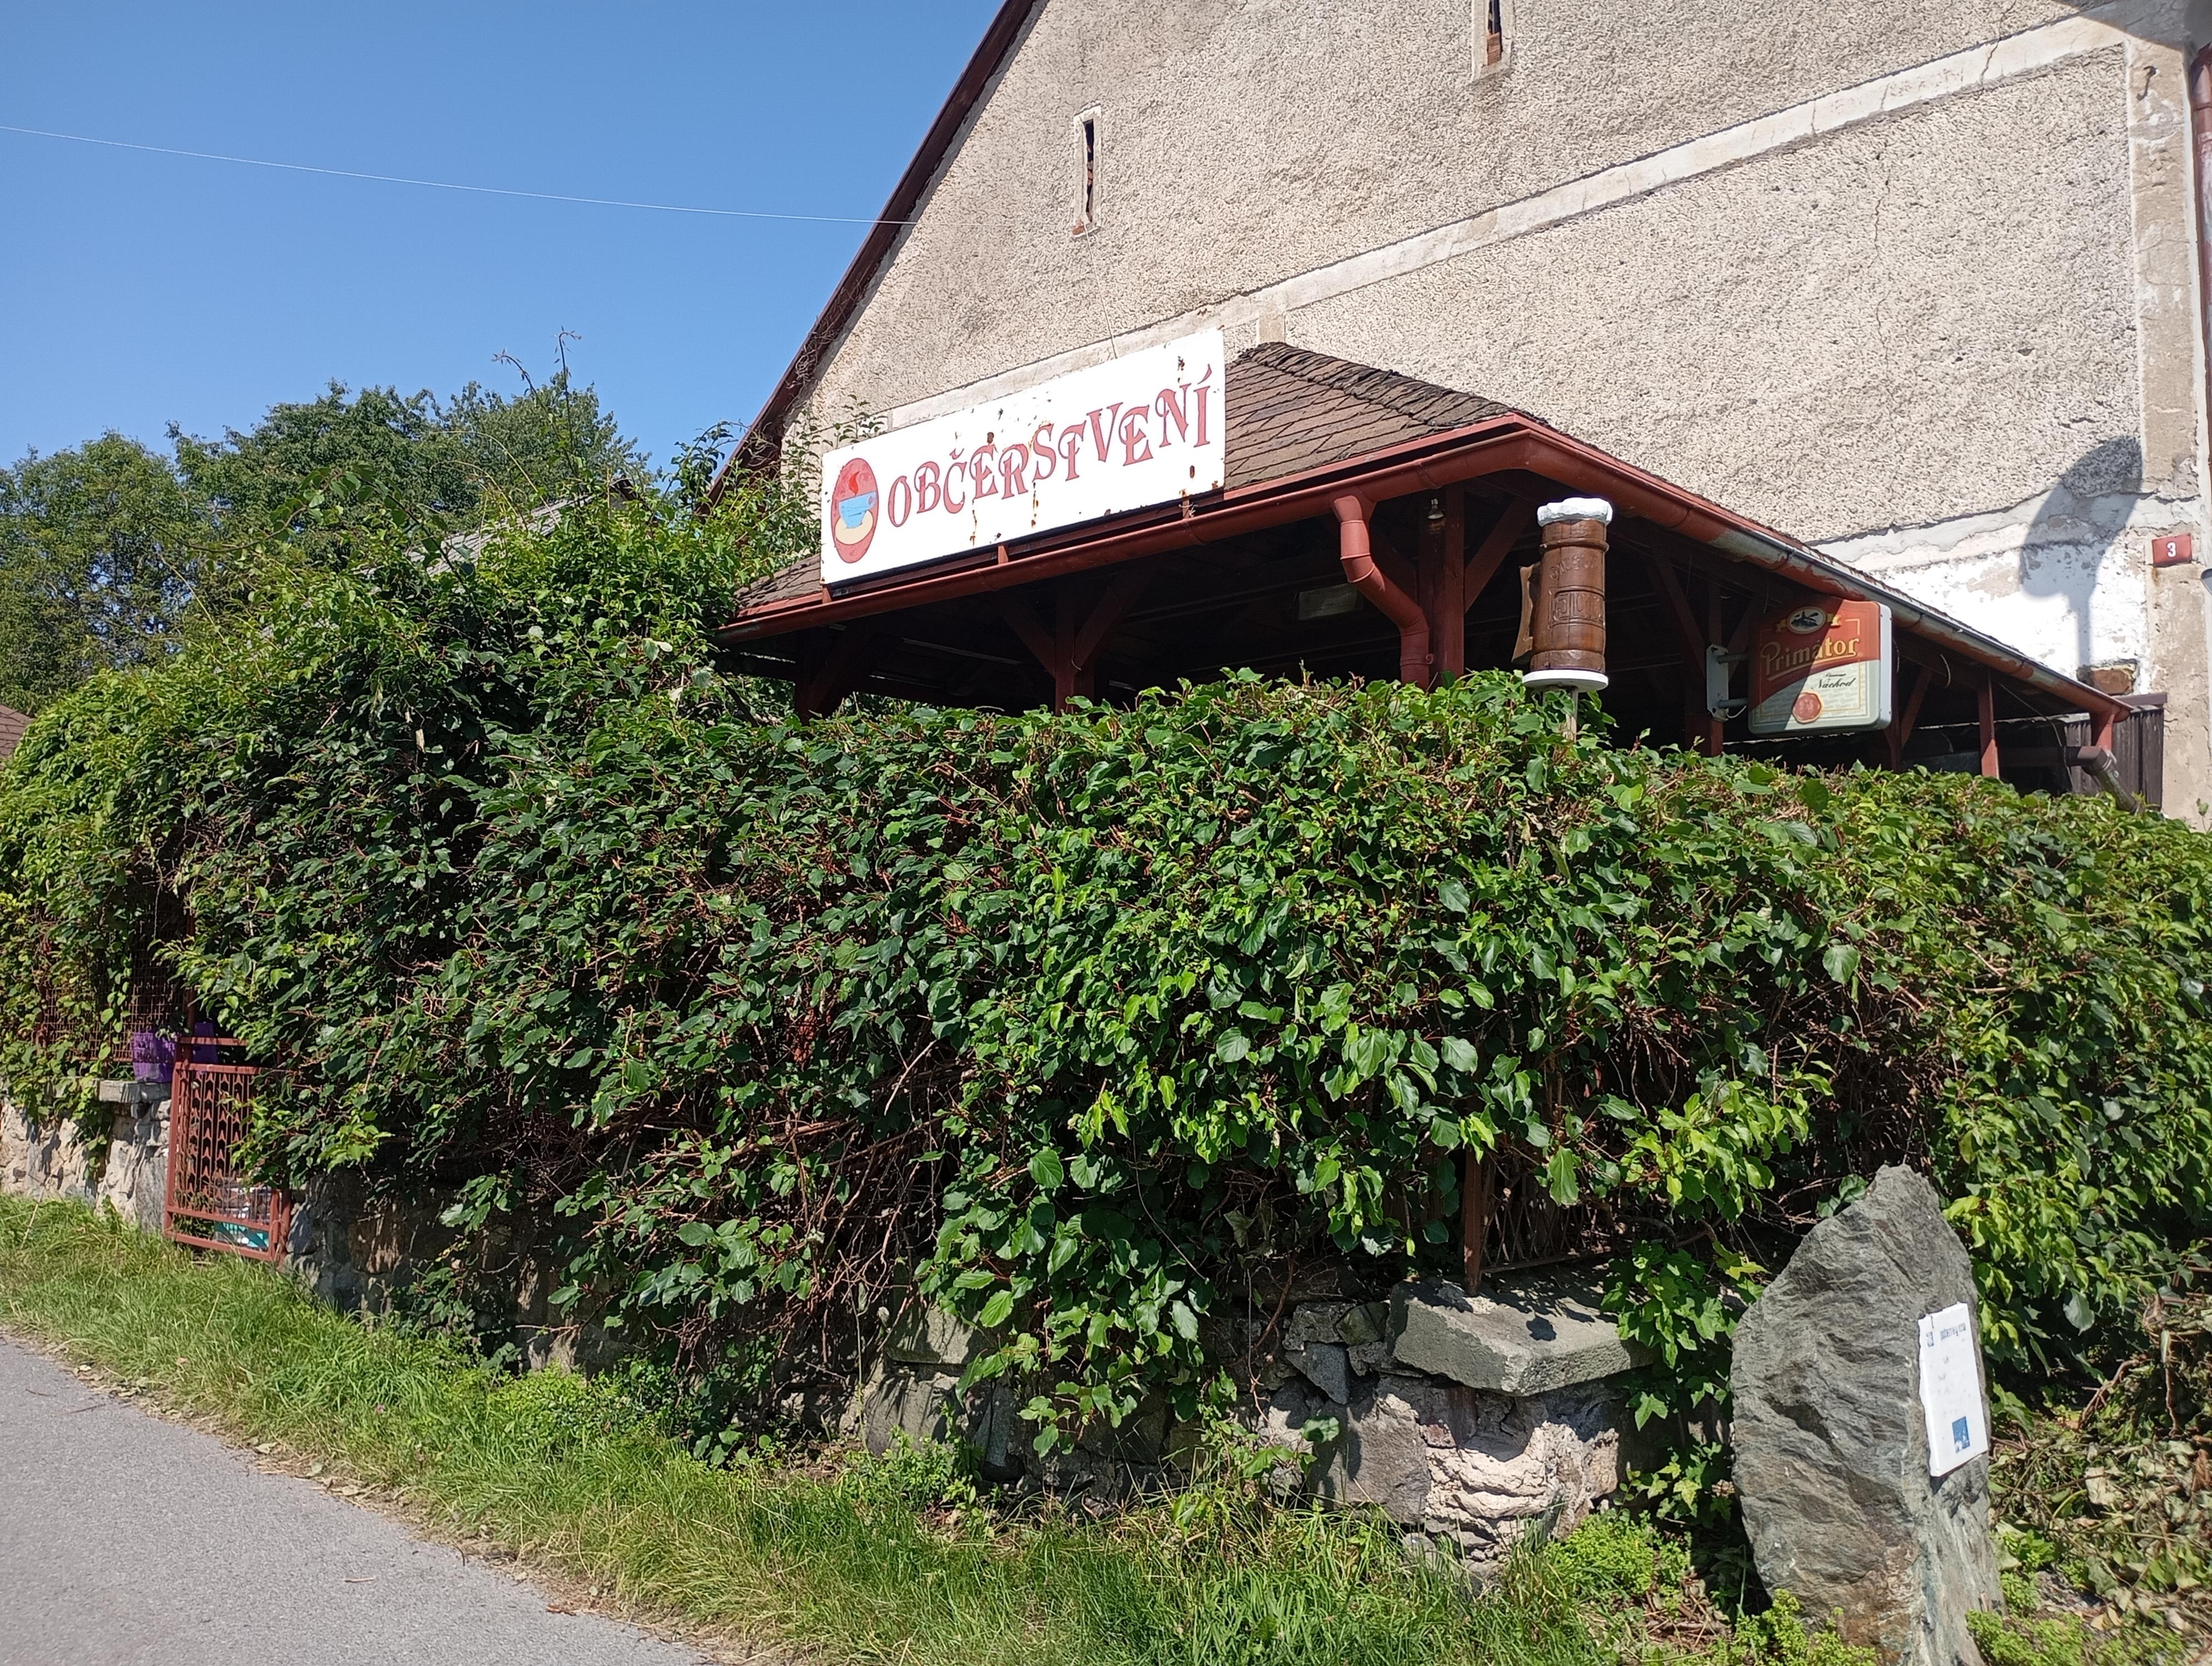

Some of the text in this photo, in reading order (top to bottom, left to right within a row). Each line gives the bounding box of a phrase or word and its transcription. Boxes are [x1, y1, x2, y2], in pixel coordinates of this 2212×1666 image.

[888, 364, 1212, 528] OBČERSTVENÍ
[2167, 542, 2176, 558] 3
[1760, 636, 1860, 676] Primátor
[1811, 678, 1856, 689] Náchod
